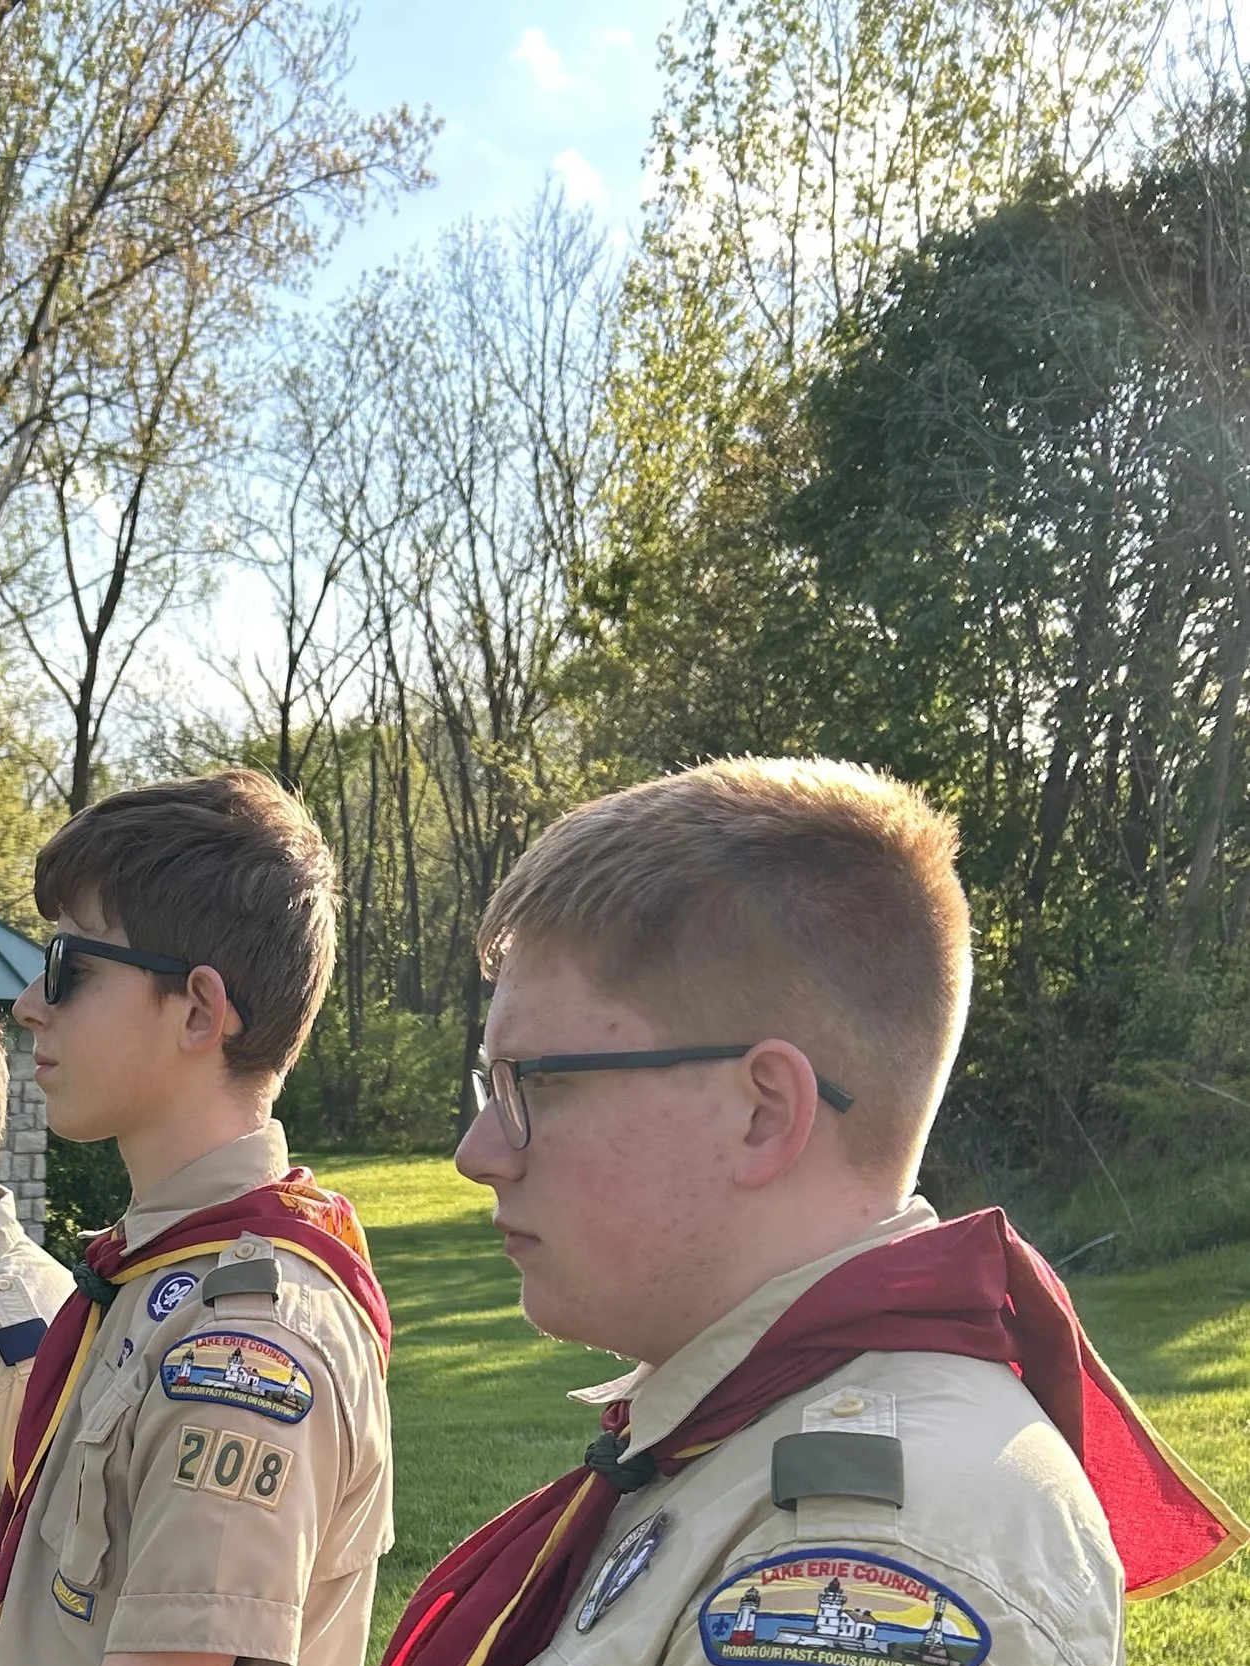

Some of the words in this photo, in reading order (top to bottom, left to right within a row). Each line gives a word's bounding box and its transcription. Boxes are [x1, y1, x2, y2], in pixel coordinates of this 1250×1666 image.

[196, 1337, 221, 1348] LAKE
[223, 1337, 247, 1347] ERIE
[249, 1341, 290, 1367] COUNCIL
[247, 1396, 258, 1405] ON
[258, 1398, 272, 1409] OUR
[272, 1403, 296, 1417] FUTURE
[178, 1432, 282, 1496] 208
[761, 1564, 804, 1585] LAKE
[807, 1562, 850, 1577] ERIE
[853, 1565, 930, 1604] COUNCIL
[722, 1645, 758, 1658] HONOR
[758, 1646, 783, 1659] OUR
